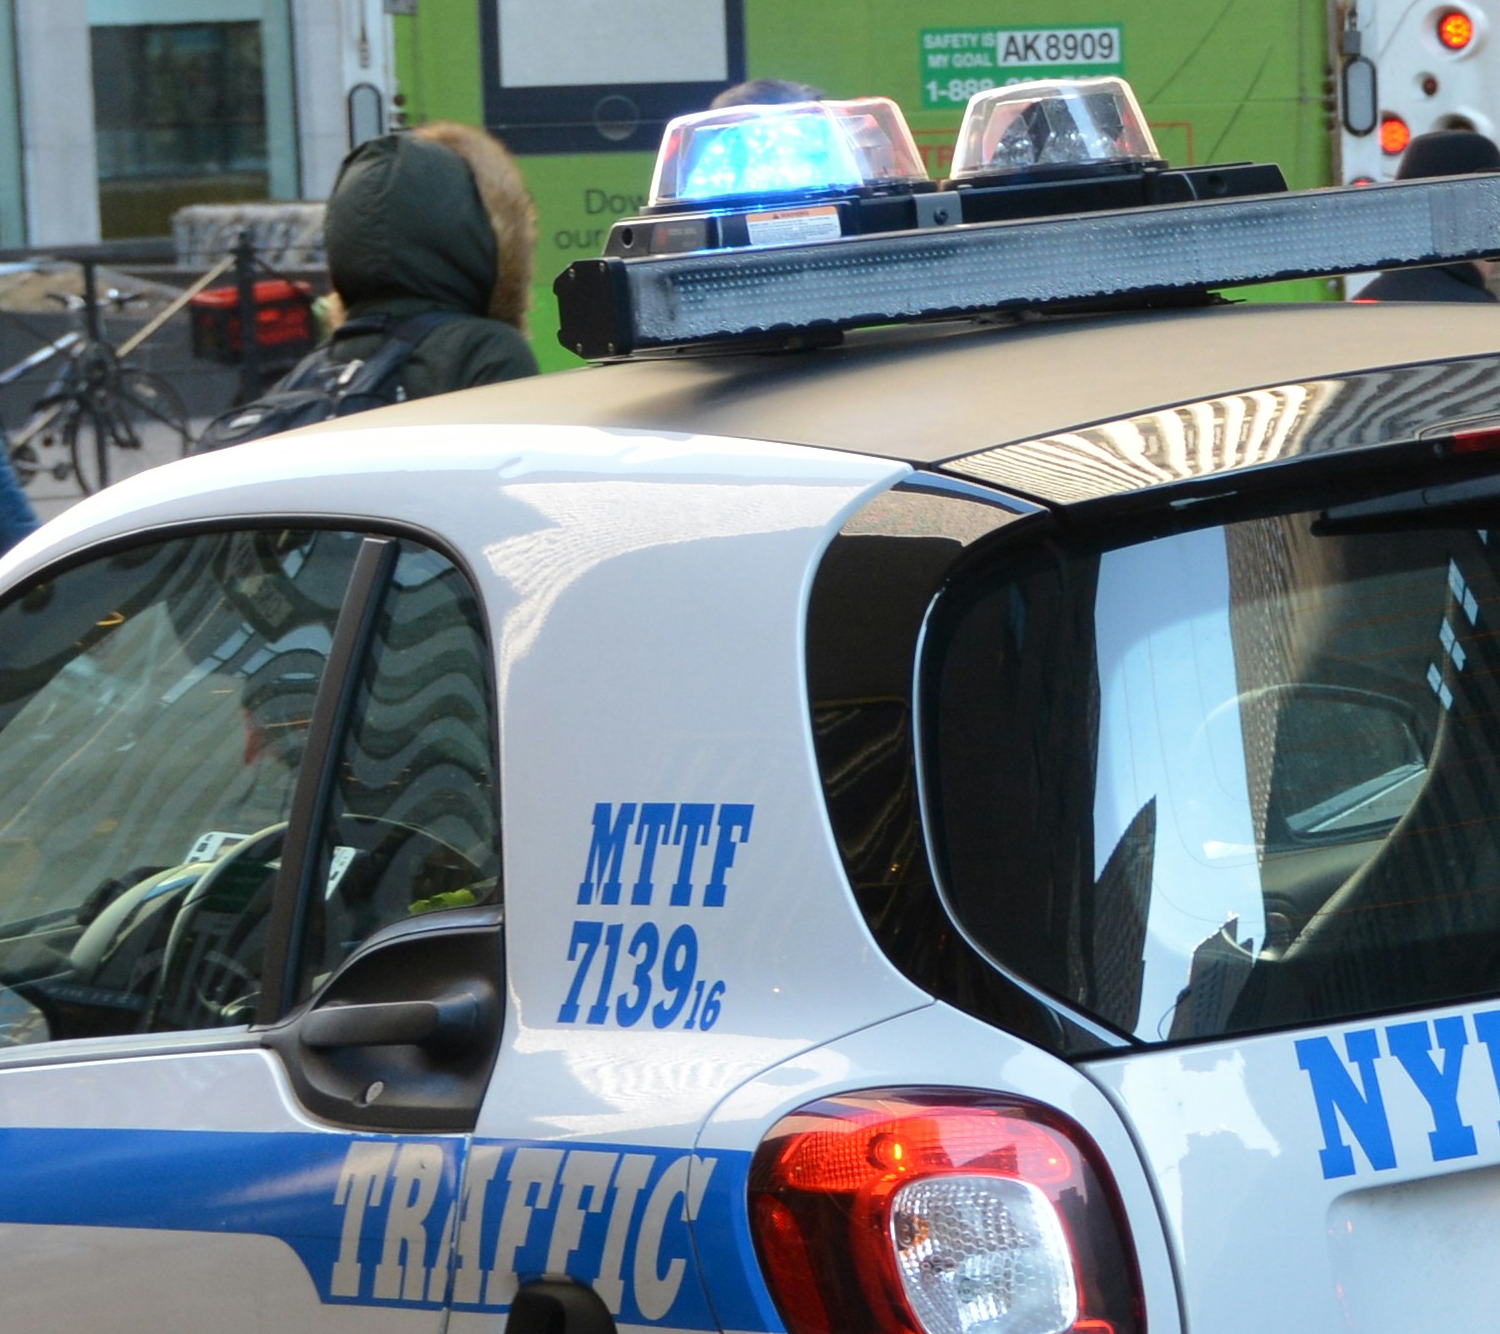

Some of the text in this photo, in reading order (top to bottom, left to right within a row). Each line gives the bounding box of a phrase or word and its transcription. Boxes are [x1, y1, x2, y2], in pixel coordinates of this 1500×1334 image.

[924, 33, 975, 49] SAFETY
[1003, 32, 1114, 63] AK8909
[953, 53, 992, 67] GOAL
[577, 802, 754, 907] MTTF
[330, 1140, 717, 1321] TRAFFIC
